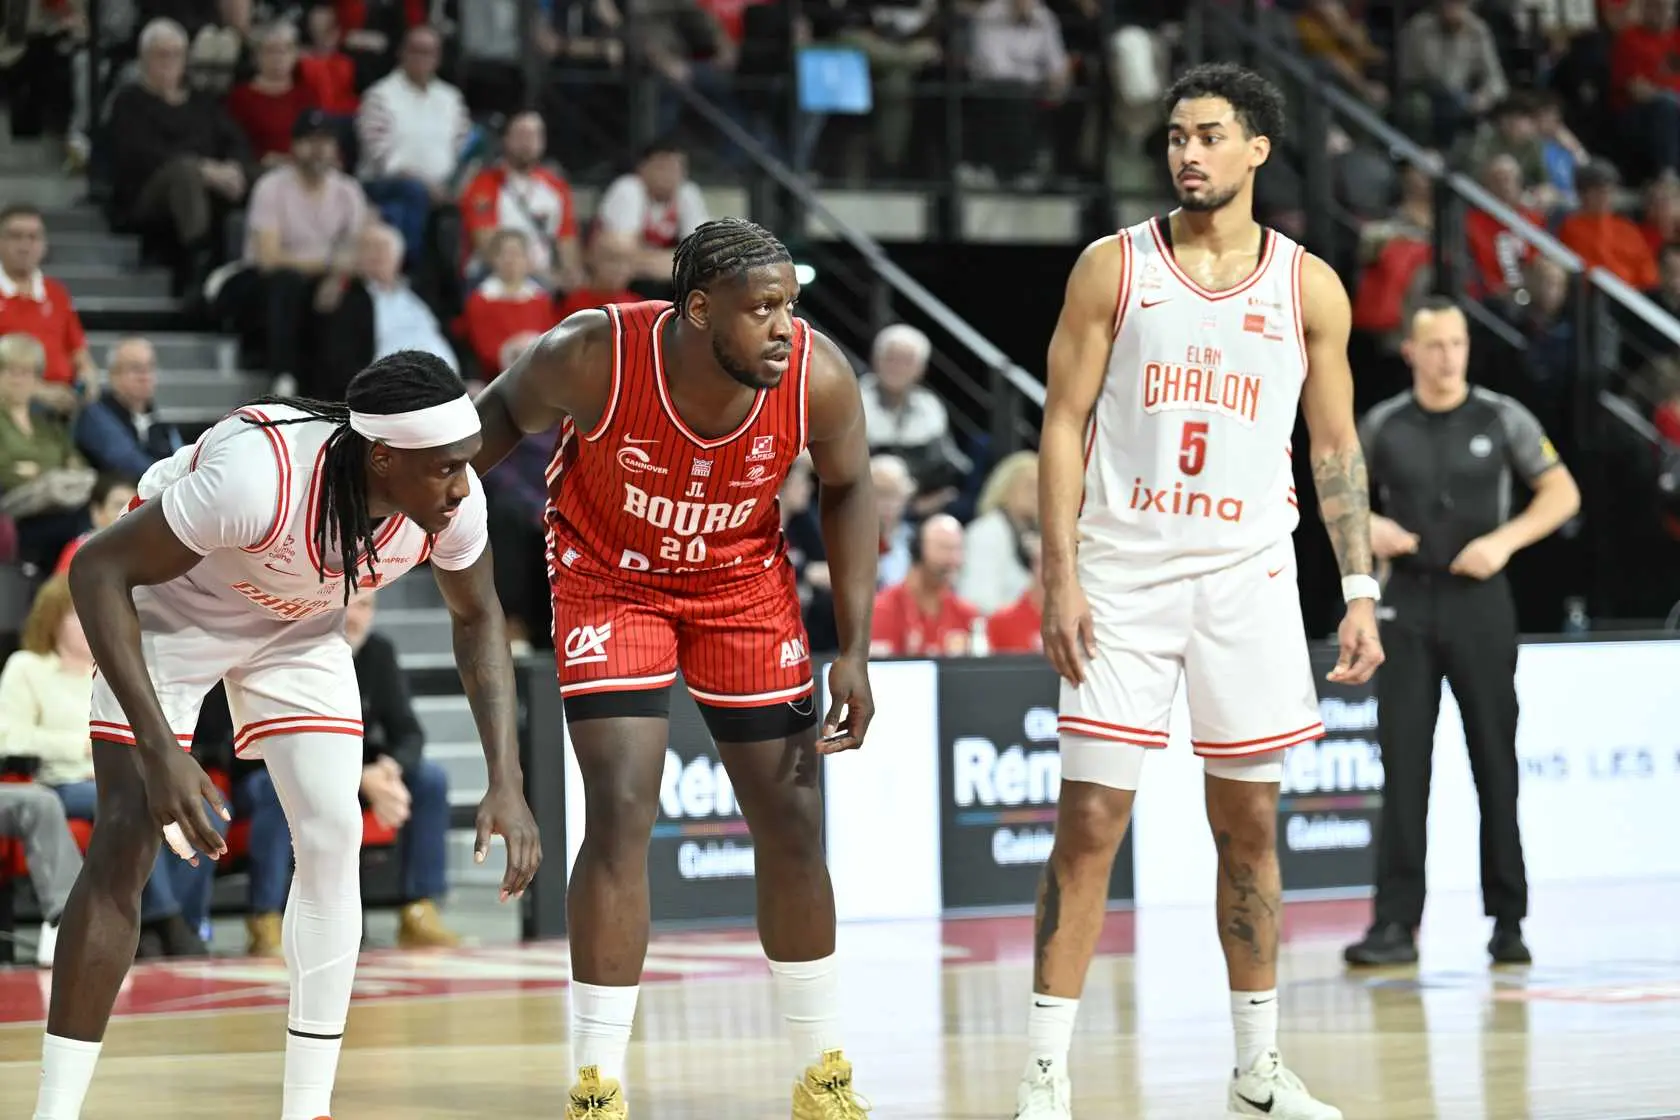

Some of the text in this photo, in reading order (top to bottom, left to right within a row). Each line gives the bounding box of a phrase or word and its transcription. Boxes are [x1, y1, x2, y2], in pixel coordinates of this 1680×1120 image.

[1187, 345, 1221, 366] ELAN
[1144, 363, 1261, 422] CHALON
[1178, 421, 1209, 477] 5
[623, 482, 758, 537] BOURG
[685, 482, 705, 498] JL
[1129, 477, 1244, 523] ixina
[660, 535, 706, 563] 20
